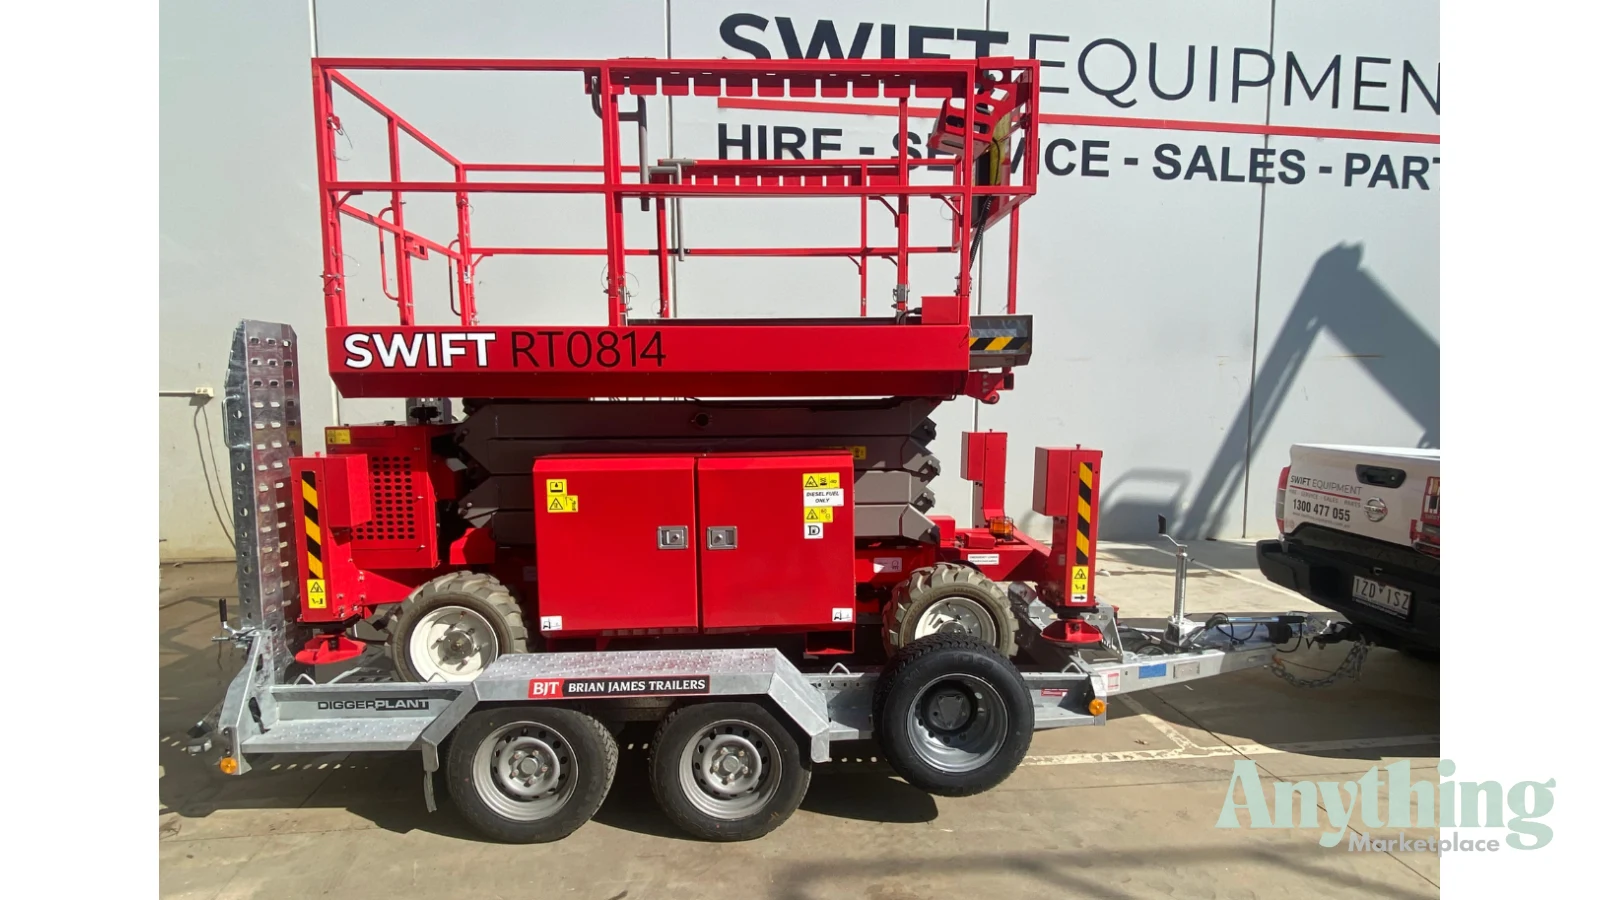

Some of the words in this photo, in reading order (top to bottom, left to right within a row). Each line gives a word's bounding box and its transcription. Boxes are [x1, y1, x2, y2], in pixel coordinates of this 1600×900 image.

[892, 132, 1110, 177] SECE
[1152, 143, 1306, 184] SALES
[344, 332, 497, 369] SWIFT
[511, 331, 667, 368] RT0814
[1290, 475, 1311, 486] SWIFT
[1312, 479, 1362, 495] EQUIPMENT
[1293, 498, 1311, 513] 1300
[1313, 503, 1330, 517] 477
[1332, 507, 1350, 521] 055
[1355, 579, 1376, 598] 1ZD
[1387, 588, 1409, 610] 1SZ
[533, 681, 559, 696] BJT
[568, 681, 605, 693] BRIAN
[607, 680, 646, 693] JAMES
[649, 679, 706, 691] TRAILERS
[318, 699, 429, 710] DIGGERPLANT
